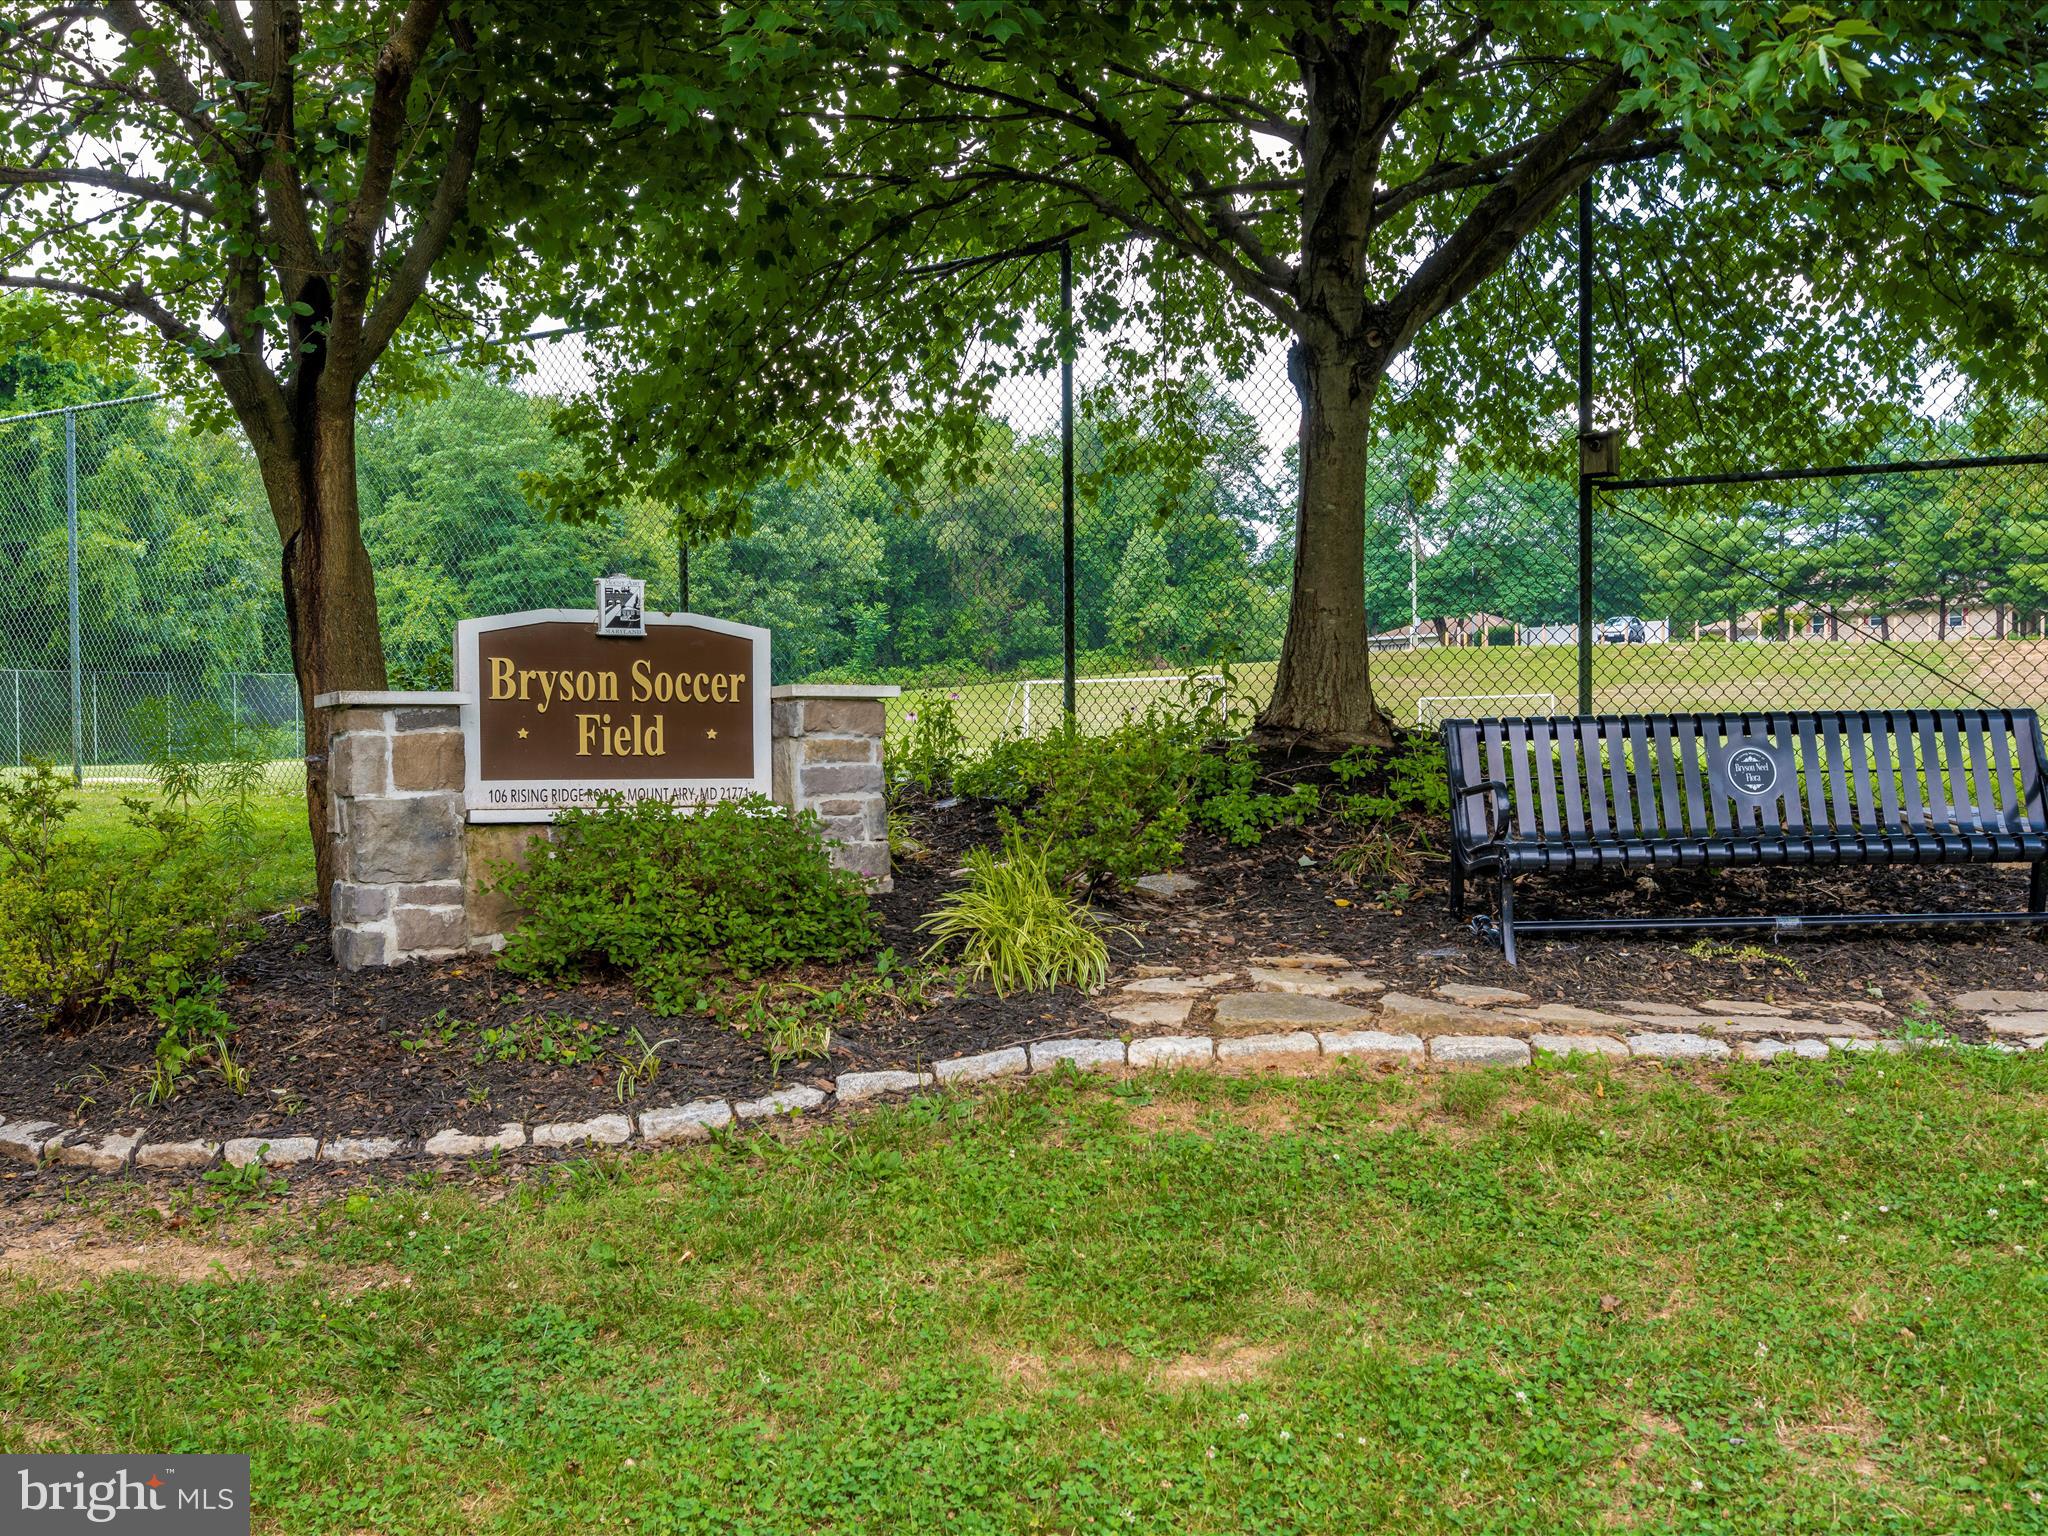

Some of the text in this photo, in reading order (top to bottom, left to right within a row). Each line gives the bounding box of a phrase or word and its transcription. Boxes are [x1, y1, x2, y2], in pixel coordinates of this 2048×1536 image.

[488, 657, 746, 713] Bryson Soccer
[575, 714, 666, 756] Field
[1735, 763, 1769, 774] Bryson Neel
[1746, 773, 1761, 782] Flora
[488, 789, 508, 803] 106
[511, 789, 548, 803] RISING
[552, 788, 584, 803] RIDGE
[587, 788, 618, 802] ROD
[627, 787, 669, 801] MOUNT
[701, 787, 718, 801] MD
[720, 786, 749, 800] 21771
